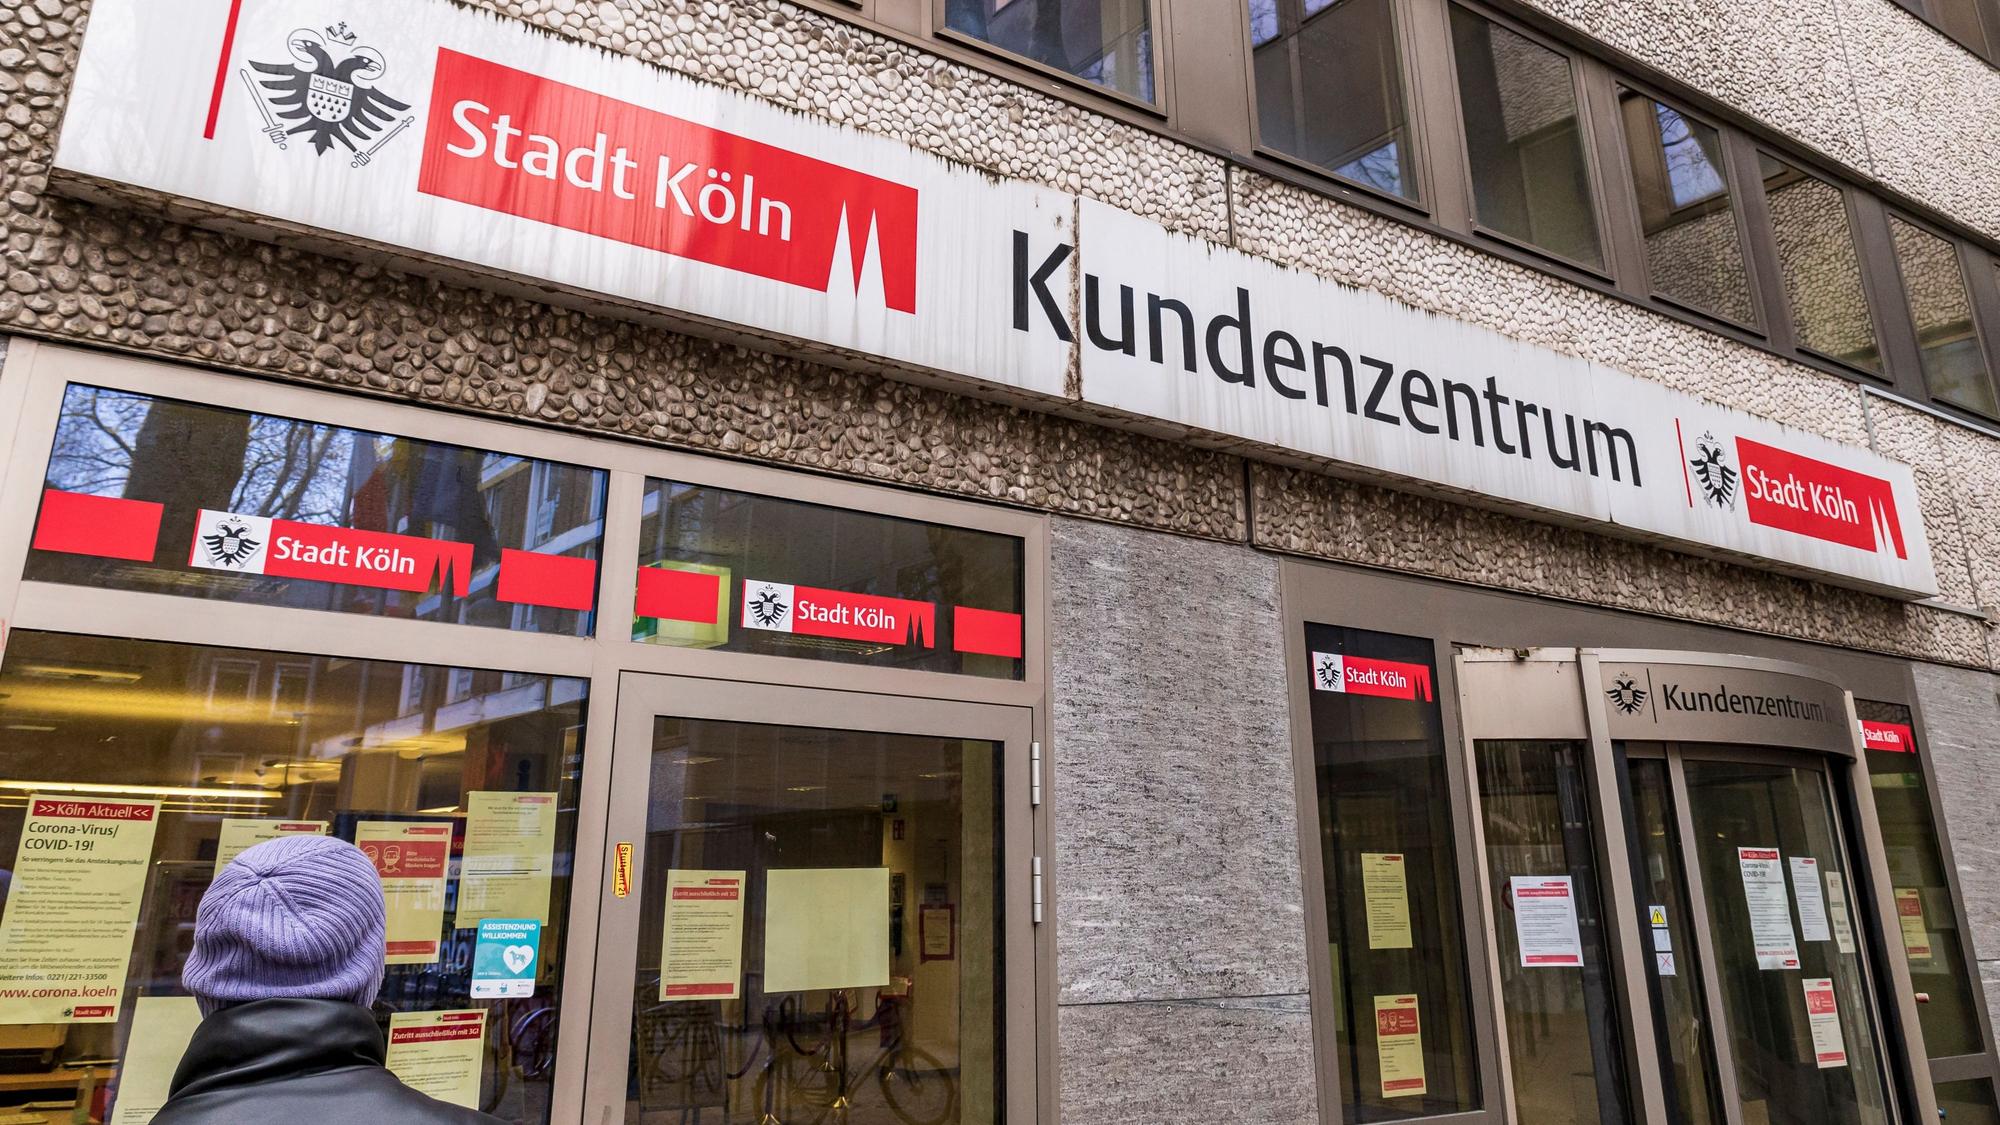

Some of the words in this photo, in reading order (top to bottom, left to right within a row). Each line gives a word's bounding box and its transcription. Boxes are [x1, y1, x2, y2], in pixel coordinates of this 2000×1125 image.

[446, 100, 637, 200] Stadt
[655, 155, 791, 241] Köln
[1013, 229, 1642, 487] Kundenzentrum
[1747, 464, 1808, 512] Stadt
[1809, 482, 1860, 525] Köln
[274, 536, 352, 567] Stadt
[357, 545, 415, 575] Köln
[797, 600, 850, 625] Stadt
[853, 606, 896, 630] Köln
[1346, 667, 1379, 685] Stadt
[1380, 670, 1407, 688] Köln
[1663, 683, 1823, 722] Kundenzentrum
[1864, 728, 1884, 741] Stadt
[1883, 730, 1900, 743] Köln
[28, 821, 119, 838] Corona-Virus/
[24, 838, 95, 851] COVID-19!
[482, 923, 537, 931] ASSISTENZHUND
[482, 932, 528, 940] WILLKOMMEN
[393, 1032, 414, 1040] Zutritt
